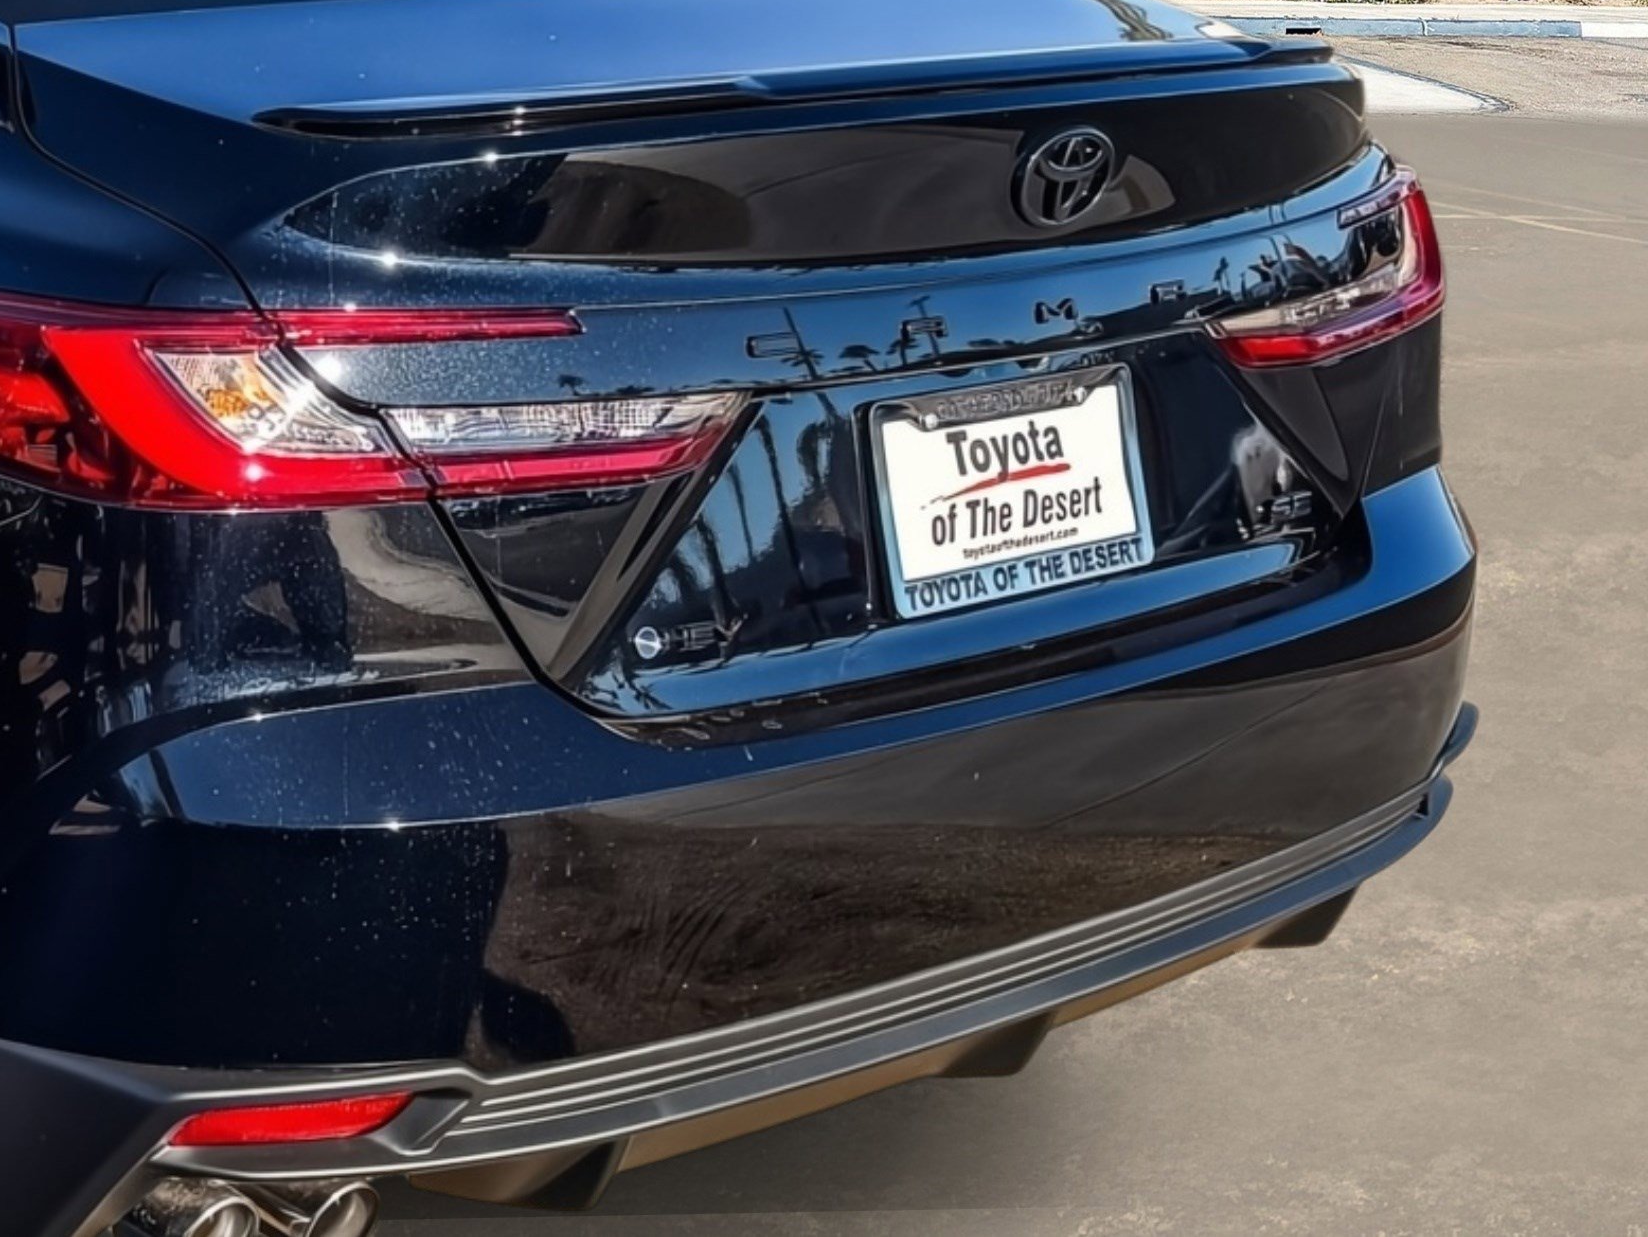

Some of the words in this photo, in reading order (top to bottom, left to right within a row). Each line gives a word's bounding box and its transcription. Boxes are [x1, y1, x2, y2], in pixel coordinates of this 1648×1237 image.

[946, 421, 1064, 482] Toyota
[931, 503, 957, 546] of
[965, 497, 1012, 539] The
[1022, 476, 1102, 528] Desert
[905, 573, 988, 611] TOYOTA
[992, 564, 1019, 592] OF
[1024, 552, 1066, 587] THE
[1069, 536, 1143, 576] DESERT
